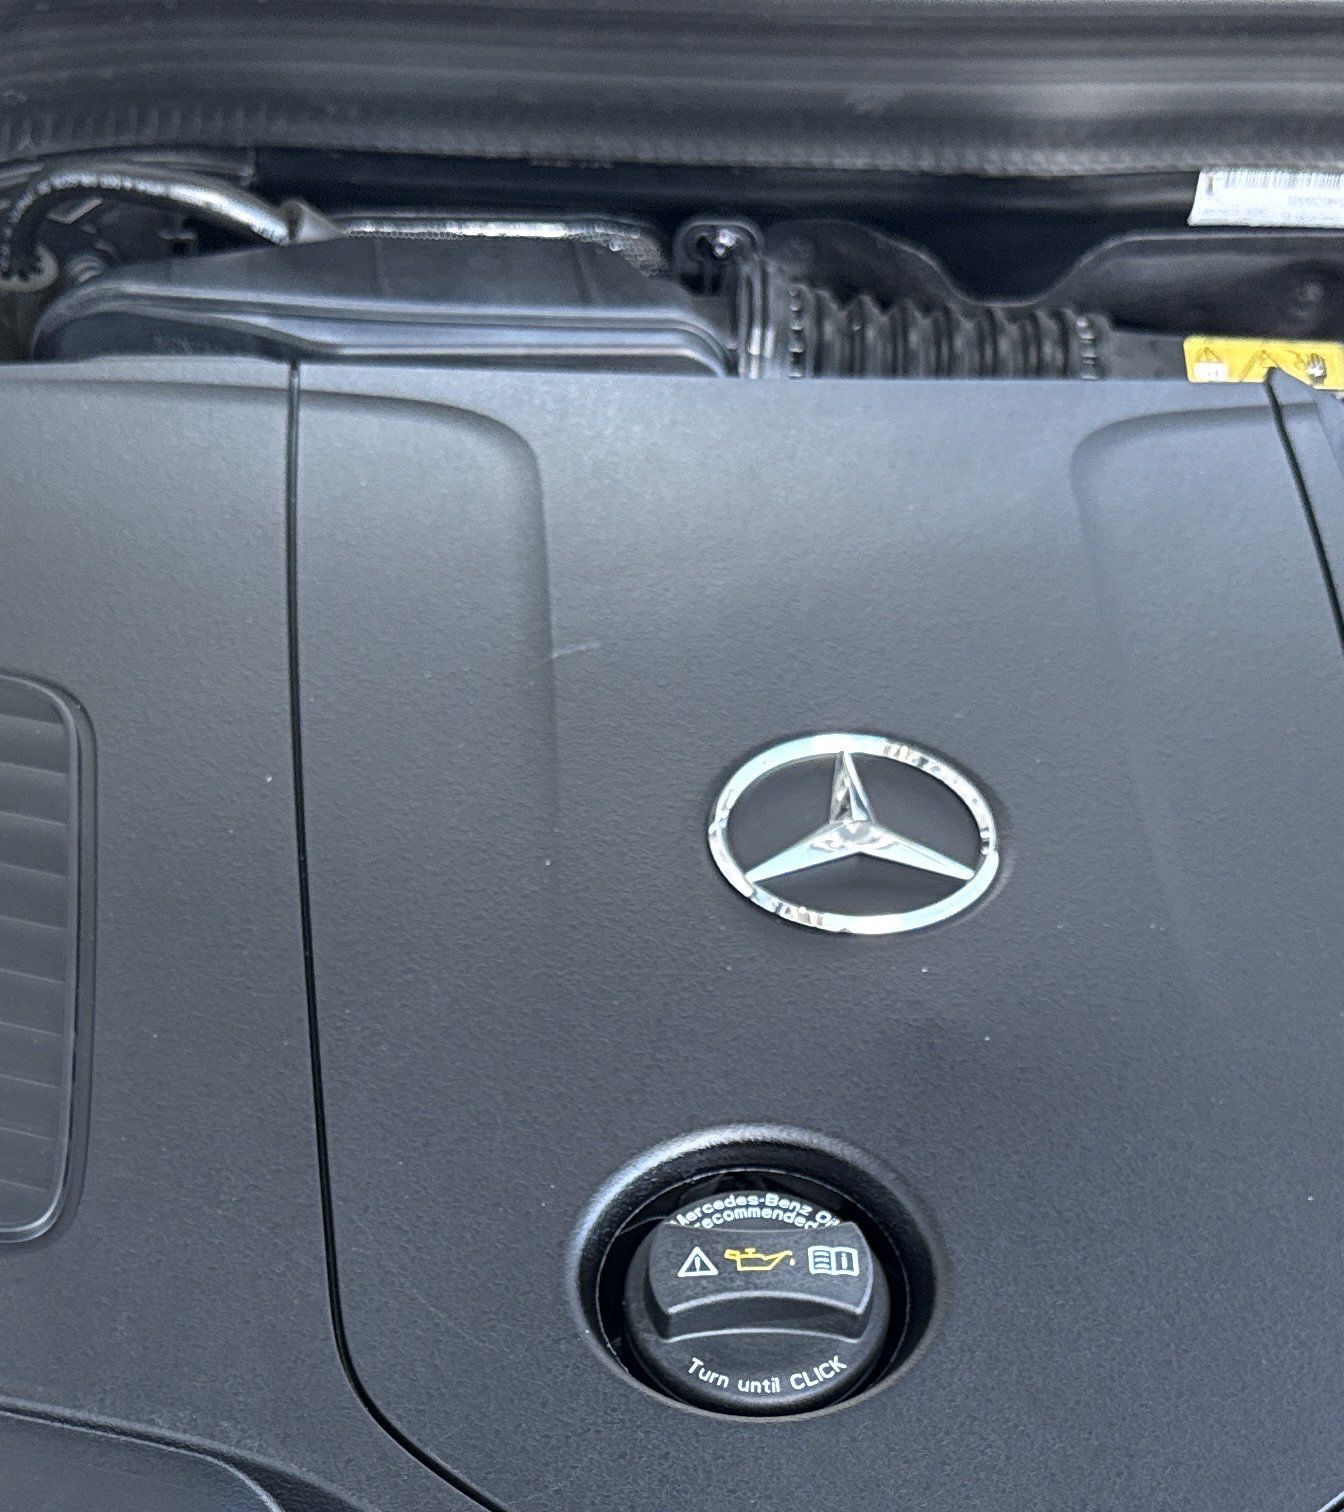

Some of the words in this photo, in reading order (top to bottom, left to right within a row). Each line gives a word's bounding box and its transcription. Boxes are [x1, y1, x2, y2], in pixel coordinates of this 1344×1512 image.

[687, 1356, 730, 1389] Turn
[737, 1376, 781, 1394] until
[789, 1355, 847, 1390] CLICK
